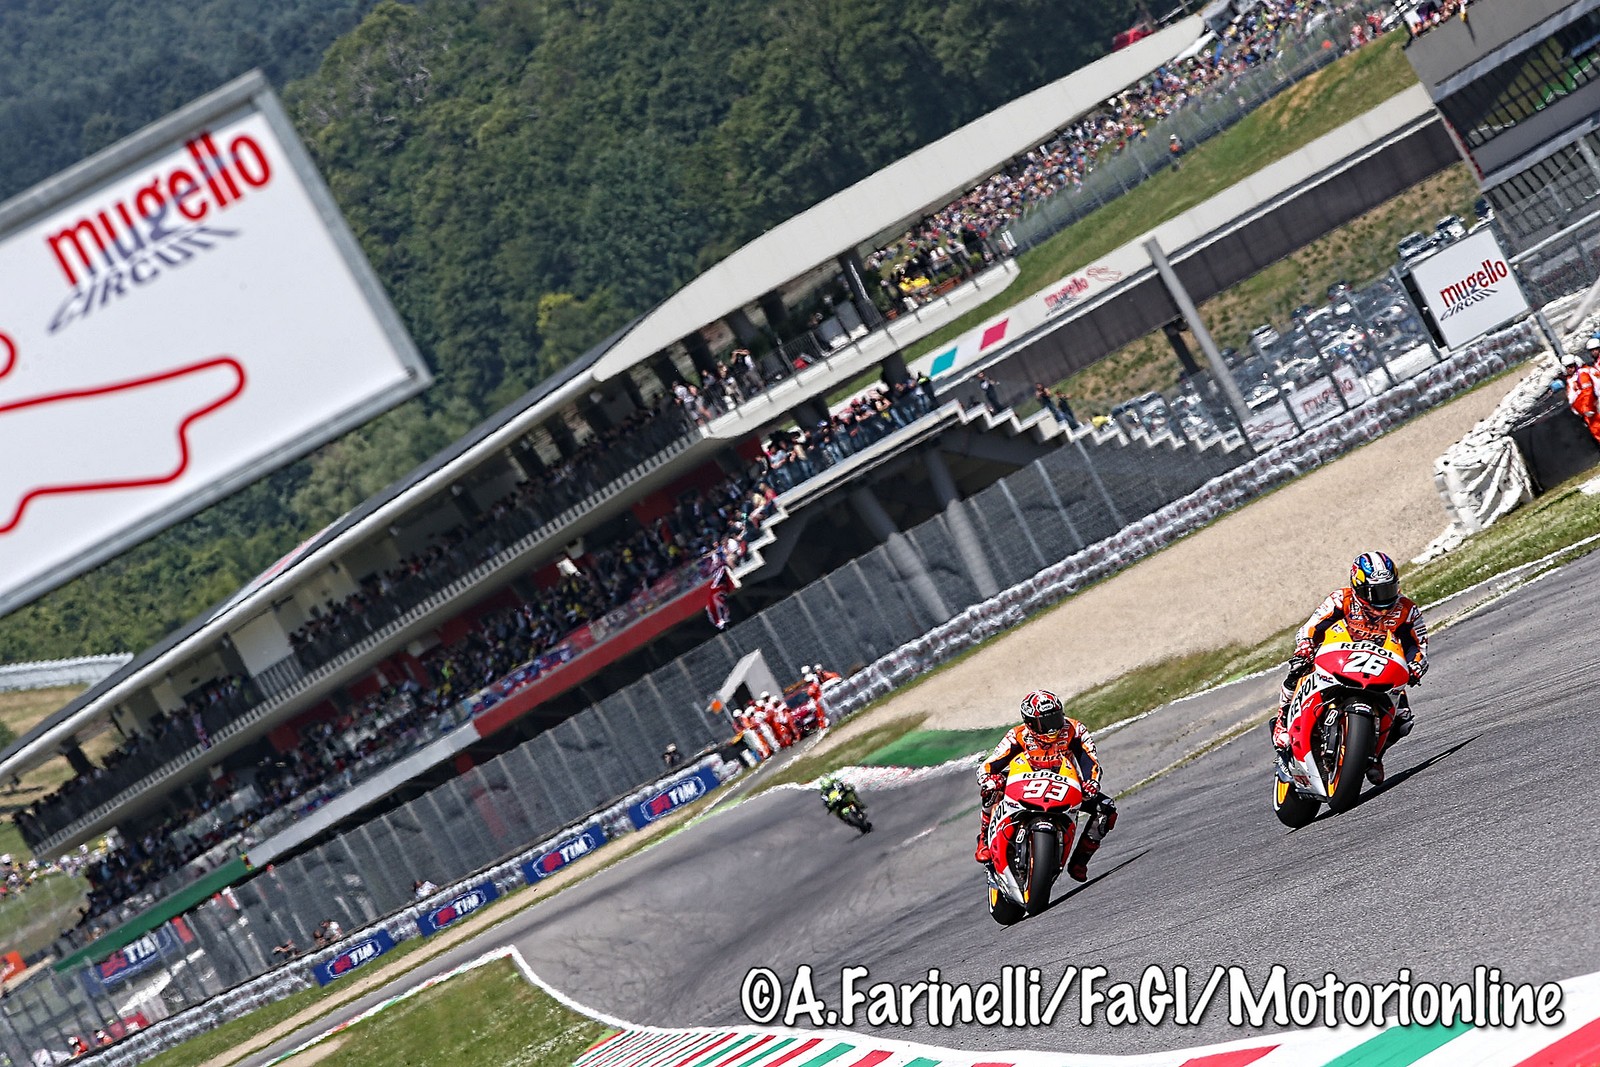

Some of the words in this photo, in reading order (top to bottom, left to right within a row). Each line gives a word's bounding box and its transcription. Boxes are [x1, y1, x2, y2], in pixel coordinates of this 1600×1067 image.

[46, 131, 272, 286] mugello
[1440, 259, 1508, 308] mugello
[1440, 288, 1498, 321] CIRCUIT
[1340, 642, 1394, 659] REPSOL
[1342, 651, 1389, 677] 26
[1023, 771, 1068, 783] REPSOL
[668, 780, 698, 806] TIM
[1023, 779, 1070, 802] 93
[559, 835, 588, 863] TIM
[454, 893, 480, 916] TIM
[350, 943, 375, 966] TIM
